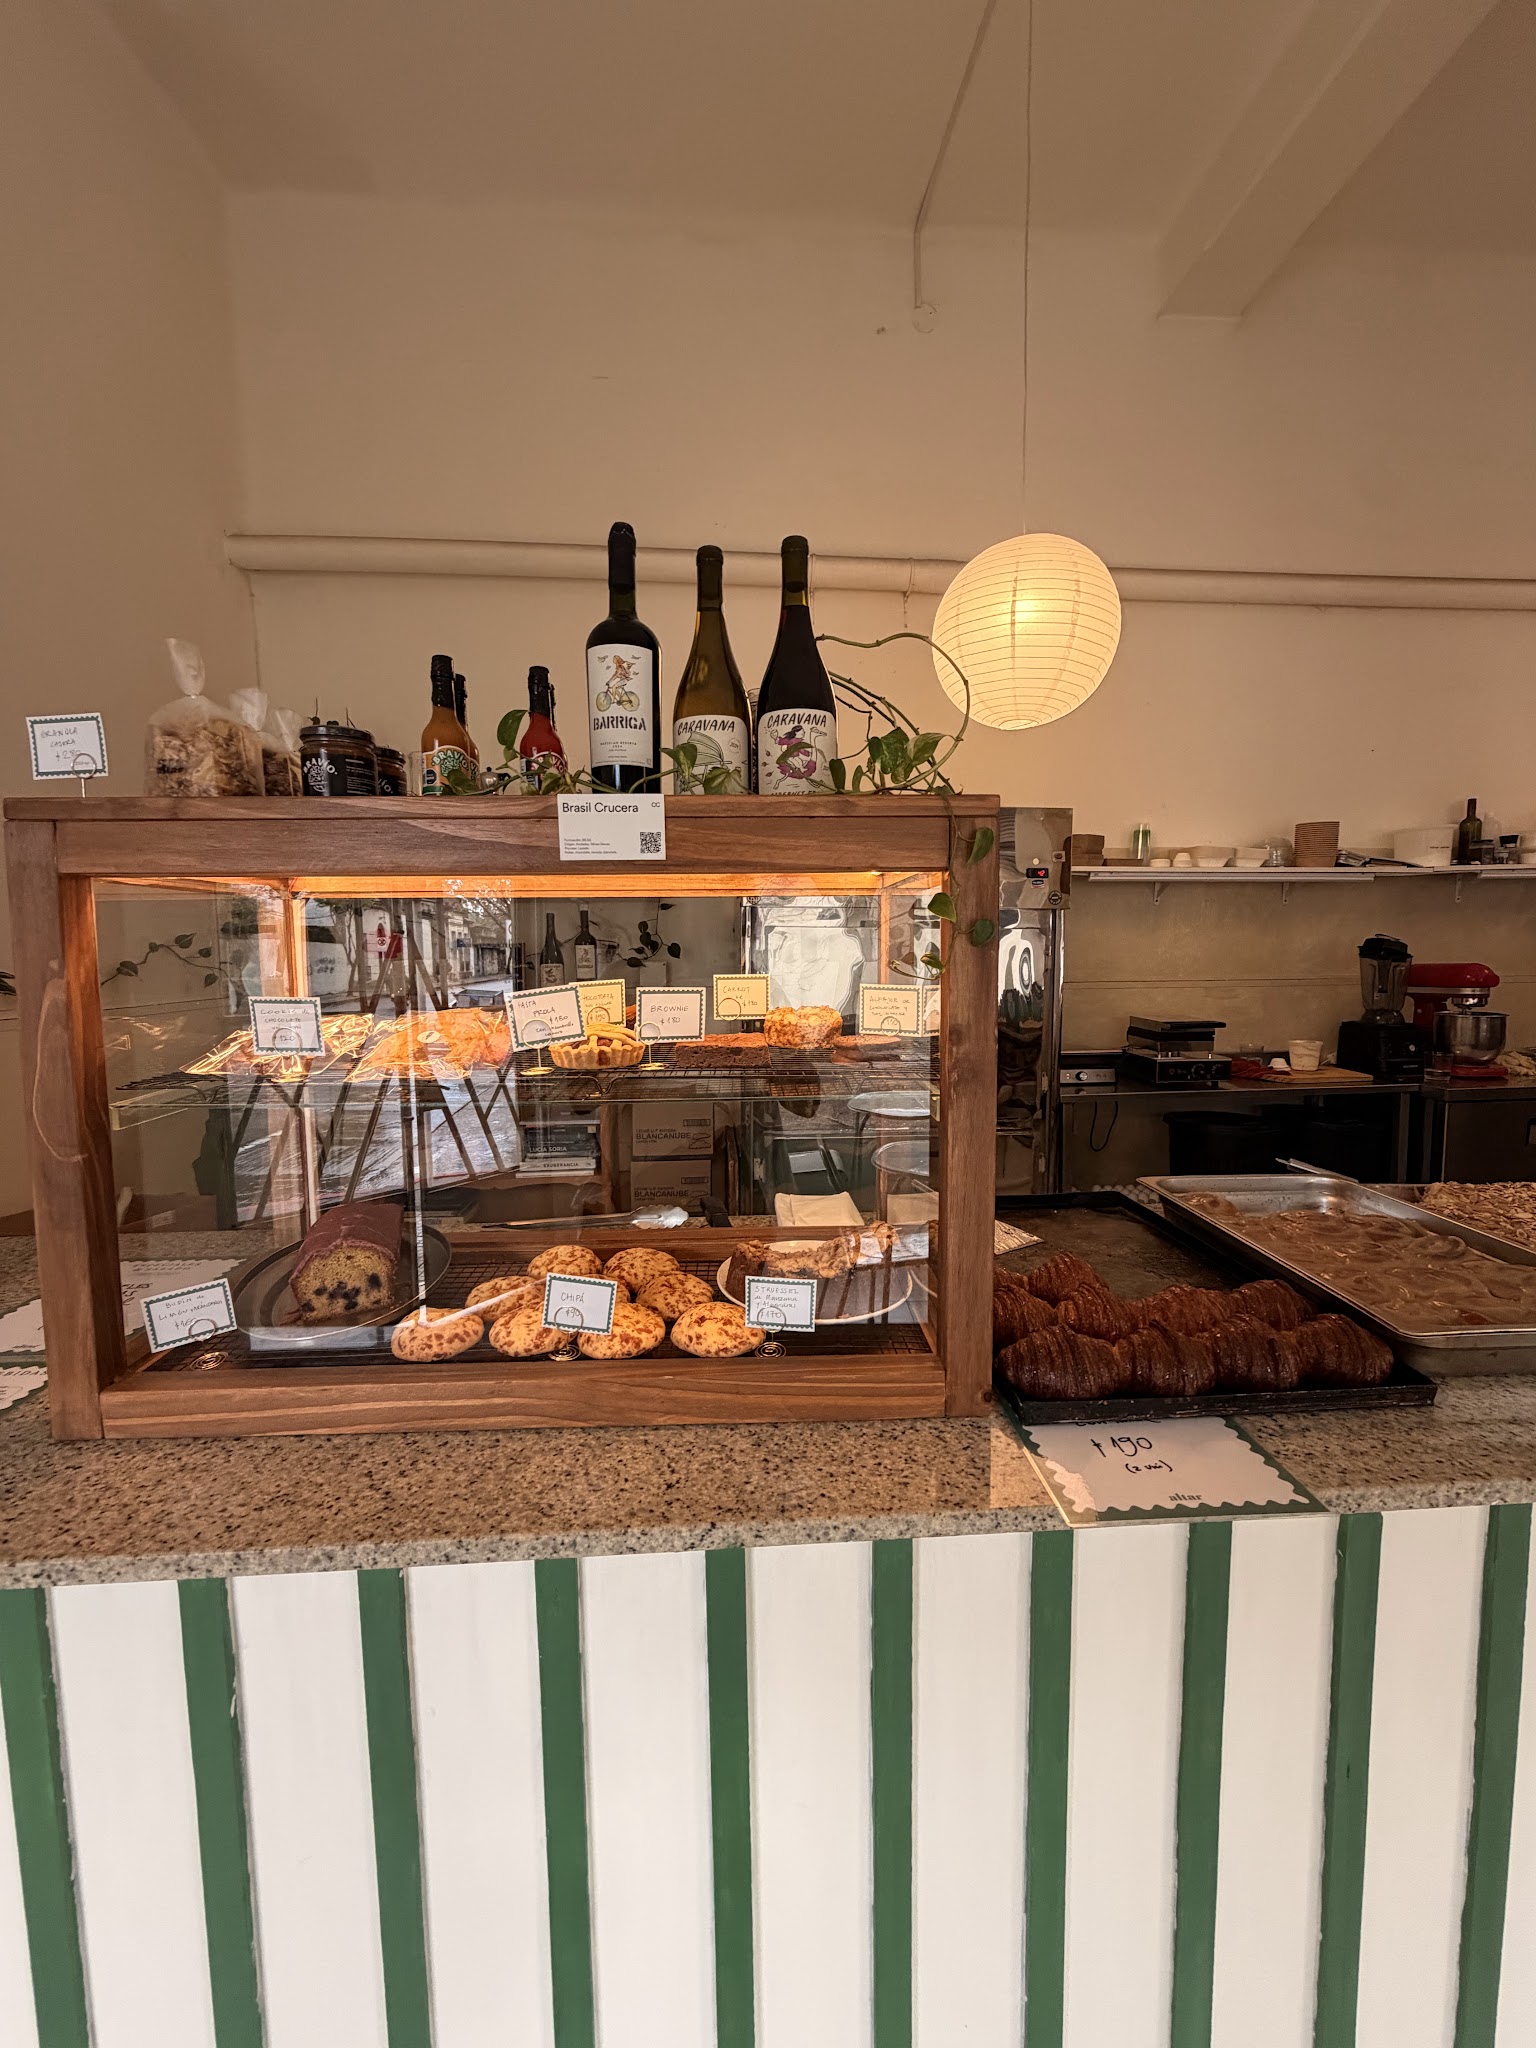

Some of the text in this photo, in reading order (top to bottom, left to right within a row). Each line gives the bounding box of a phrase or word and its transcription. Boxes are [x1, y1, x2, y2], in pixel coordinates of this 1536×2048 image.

[593, 715, 646, 731] BARRIGA
[767, 713, 827, 729] CARAVANA
[677, 720, 735, 736] CARAVANA
[562, 802, 591, 813] Brasil
[594, 802, 639, 813] Crucera
[650, 1004, 689, 1013] BROWNIE
[636, 1132, 691, 1140] BLANCANUBE
[634, 1190, 688, 1198] BLANCANUBE
[560, 1292, 585, 1304] CHIPÁ
[1168, 1493, 1202, 1502] altar
